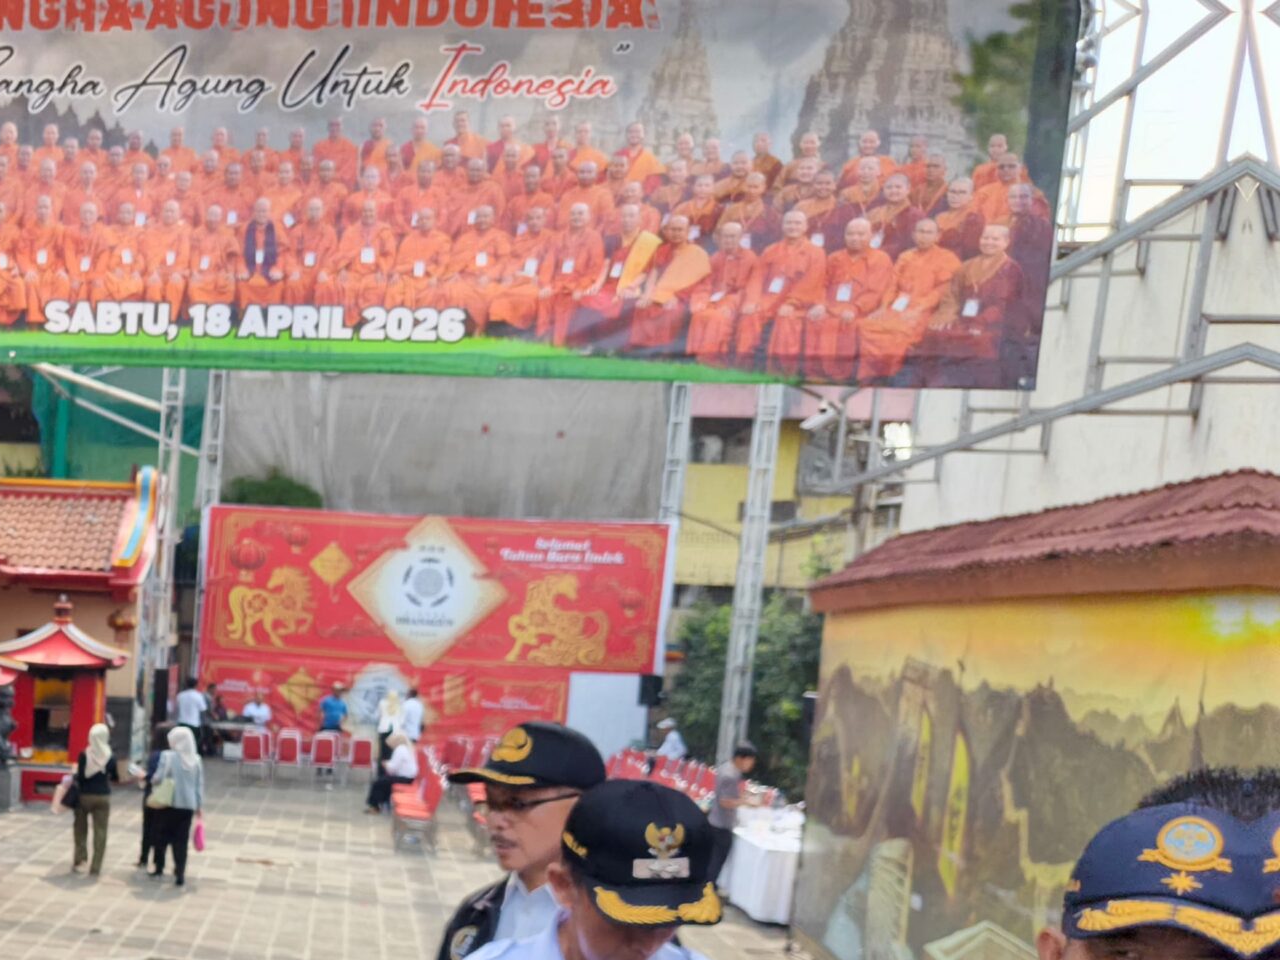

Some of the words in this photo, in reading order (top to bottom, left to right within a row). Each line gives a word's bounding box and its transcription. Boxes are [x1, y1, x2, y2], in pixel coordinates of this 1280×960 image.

[114, 44, 271, 111] Agung
[280, 44, 411, 109] Untuk
[43, 300, 179, 341] SABTU,
[187, 304, 234, 337] 18
[238, 306, 354, 340] APRIL
[359, 306, 466, 342] 2026
